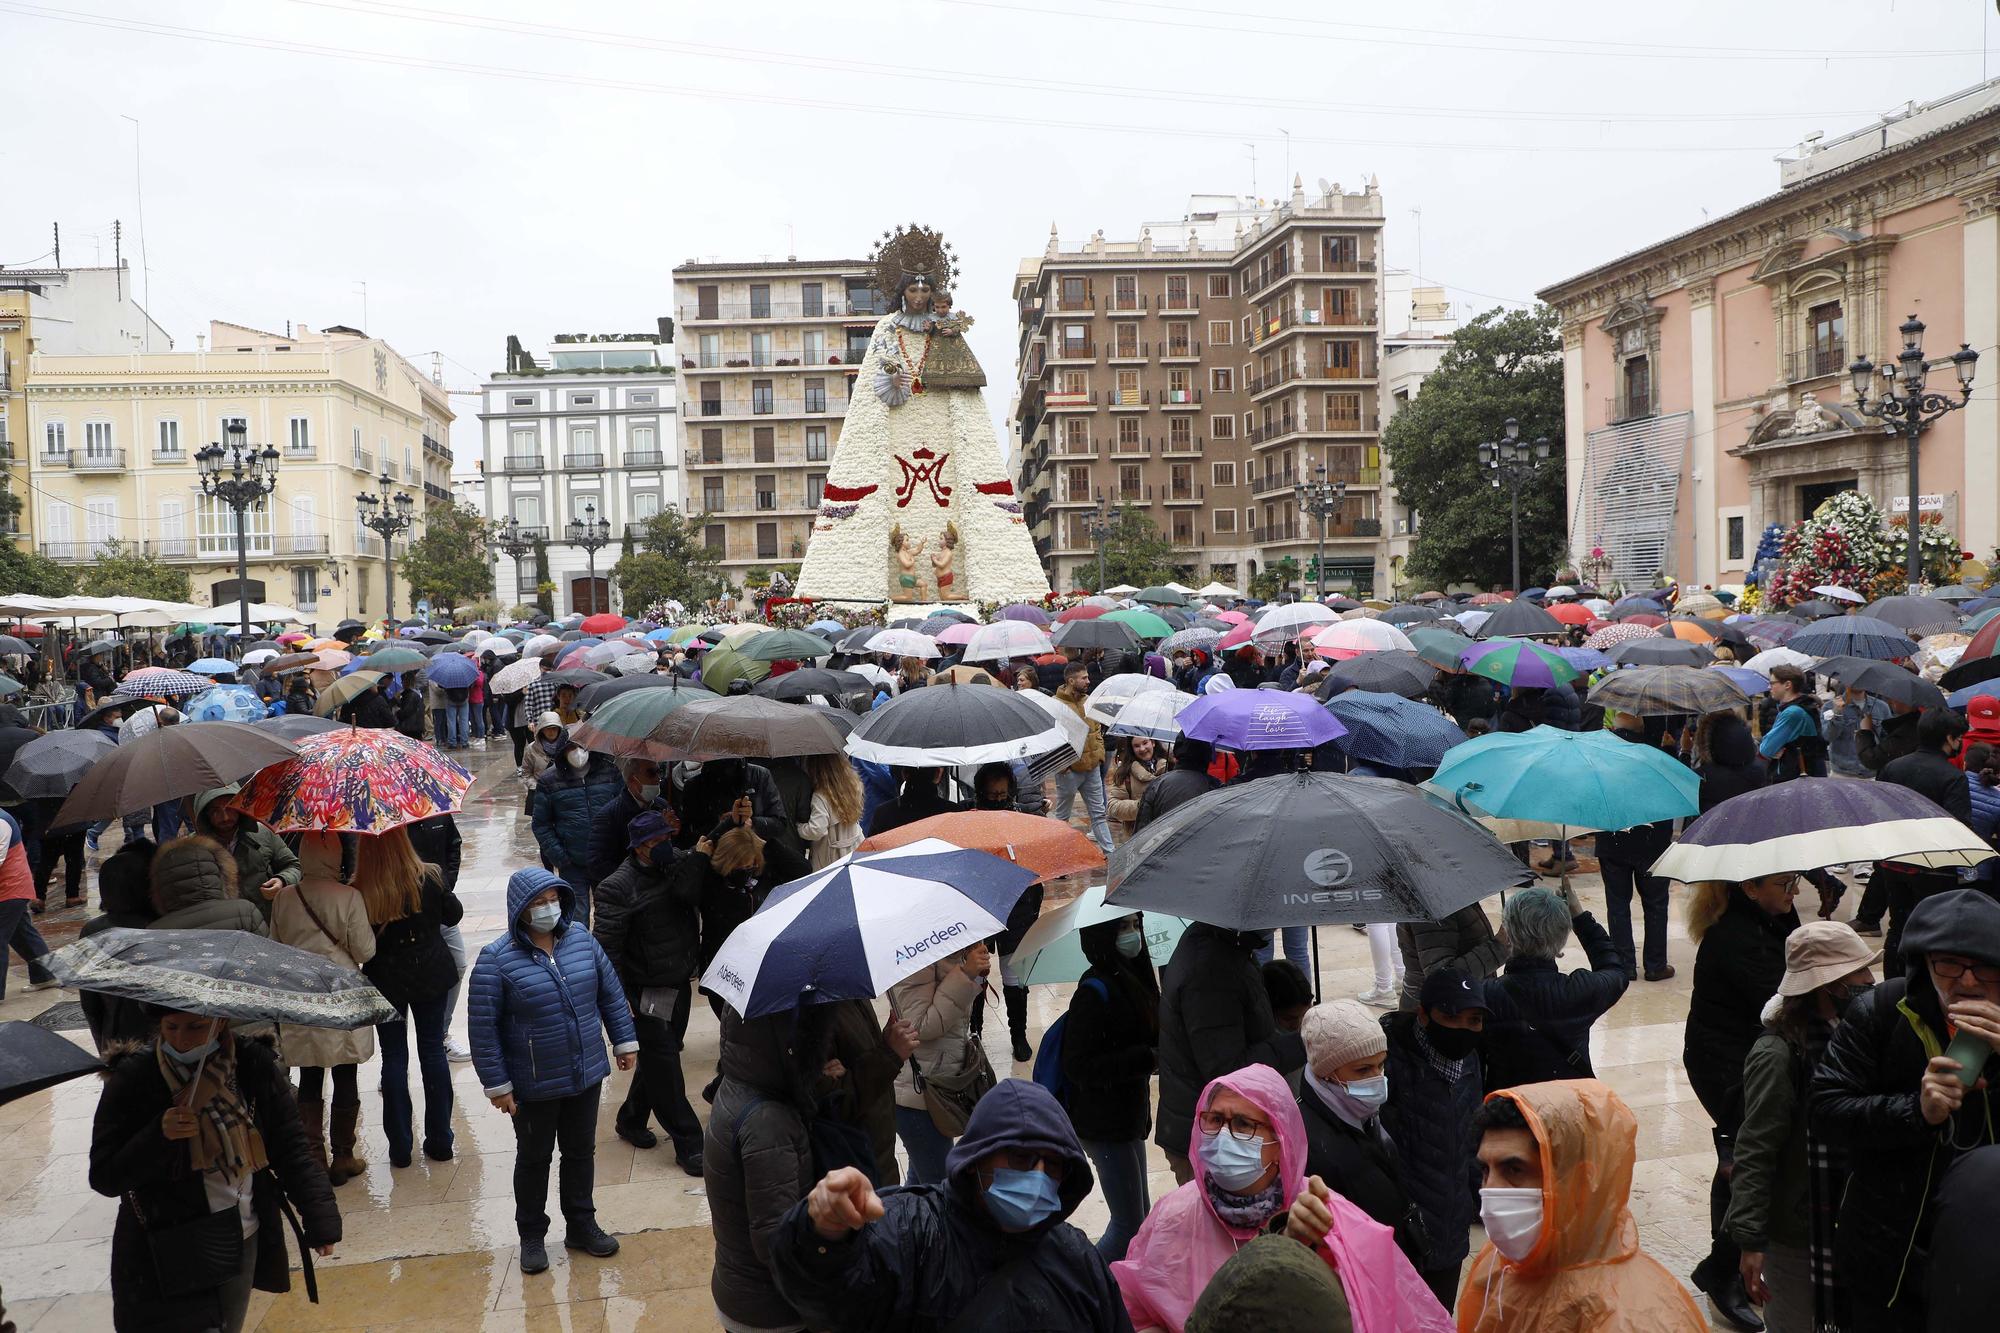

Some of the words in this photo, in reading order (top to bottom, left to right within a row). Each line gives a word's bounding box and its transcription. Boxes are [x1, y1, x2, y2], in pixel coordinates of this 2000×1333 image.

[1325, 568, 1355, 577] RMACIA
[1258, 712, 1288, 725] laugh
[1264, 721, 1287, 733] love
[1283, 889, 1382, 905] INESIS
[895, 922, 967, 965] Aberdeen
[717, 964, 745, 993] Aberdeen
